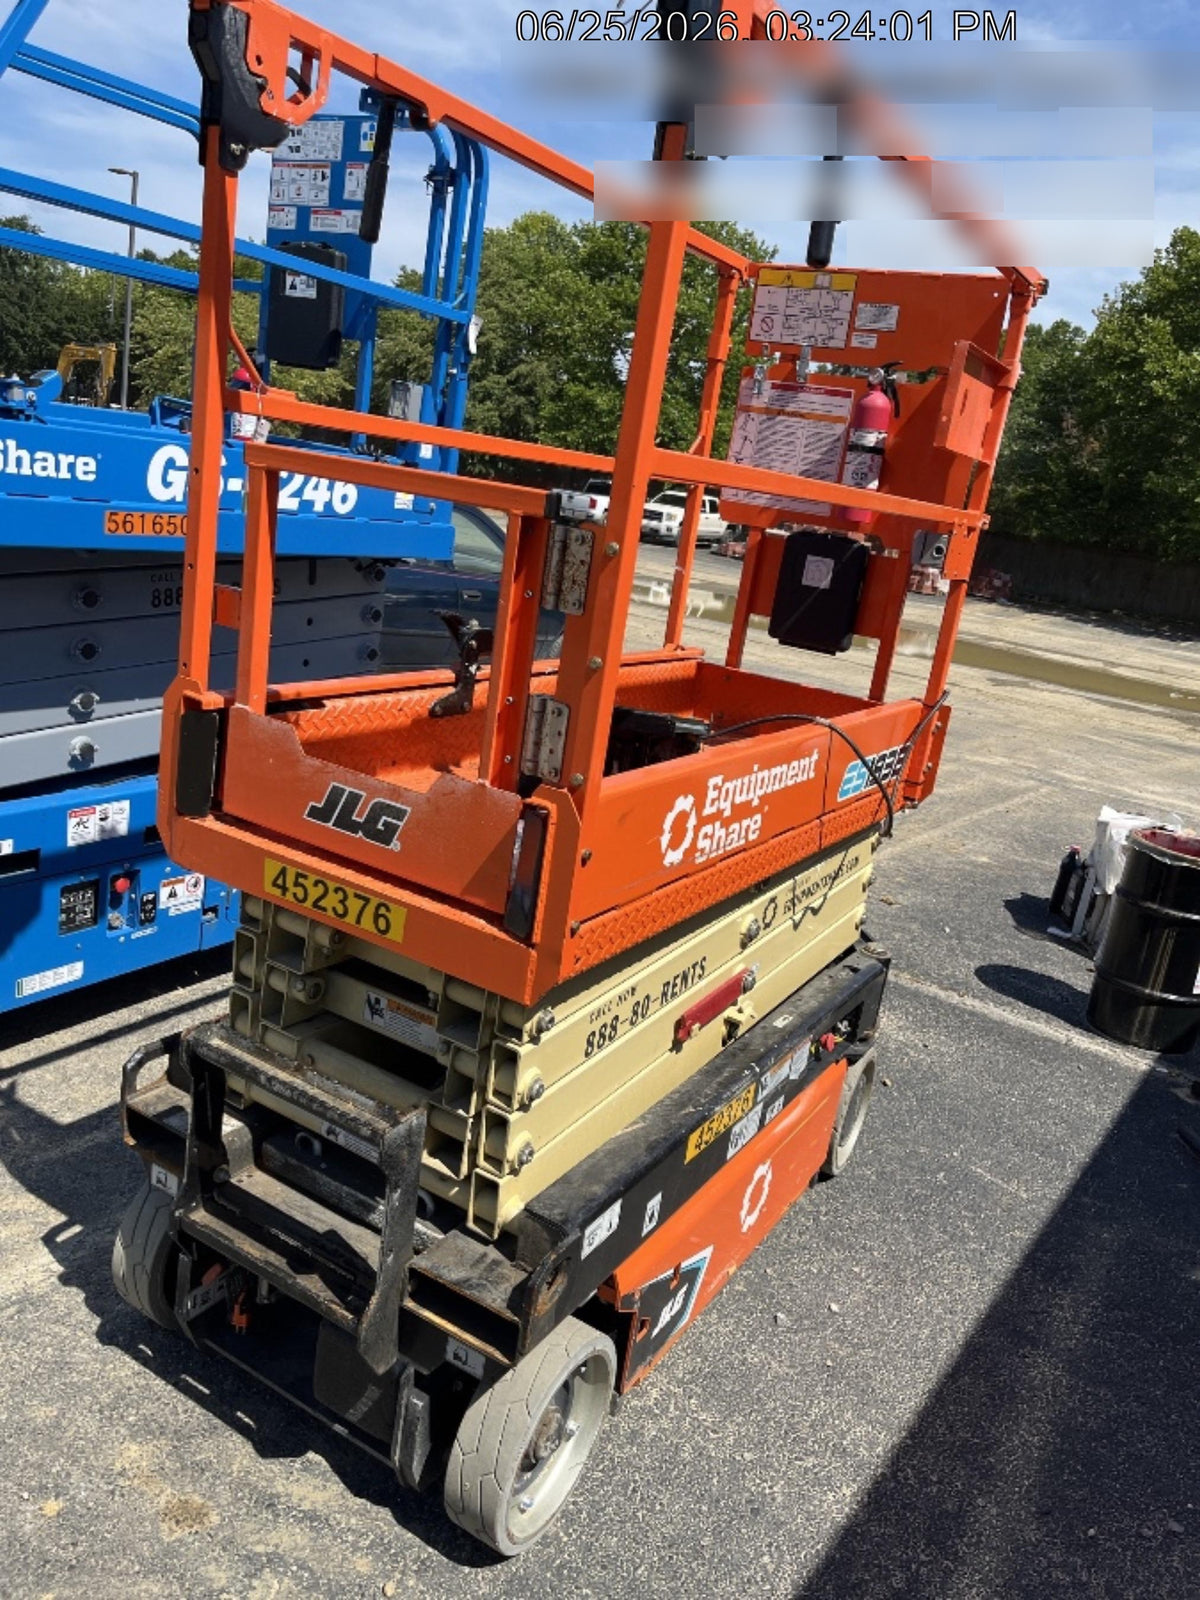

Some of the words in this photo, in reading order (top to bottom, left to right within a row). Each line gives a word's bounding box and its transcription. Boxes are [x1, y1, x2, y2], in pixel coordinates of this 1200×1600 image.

[0, 439, 97, 482] hare
[147, 445, 358, 514] G-246
[304, 782, 411, 849] JLG
[702, 750, 819, 818] Equipment
[695, 812, 762, 863] Share
[272, 866, 392, 935] 452376
[585, 956, 707, 1058] 888-80-RENTS
